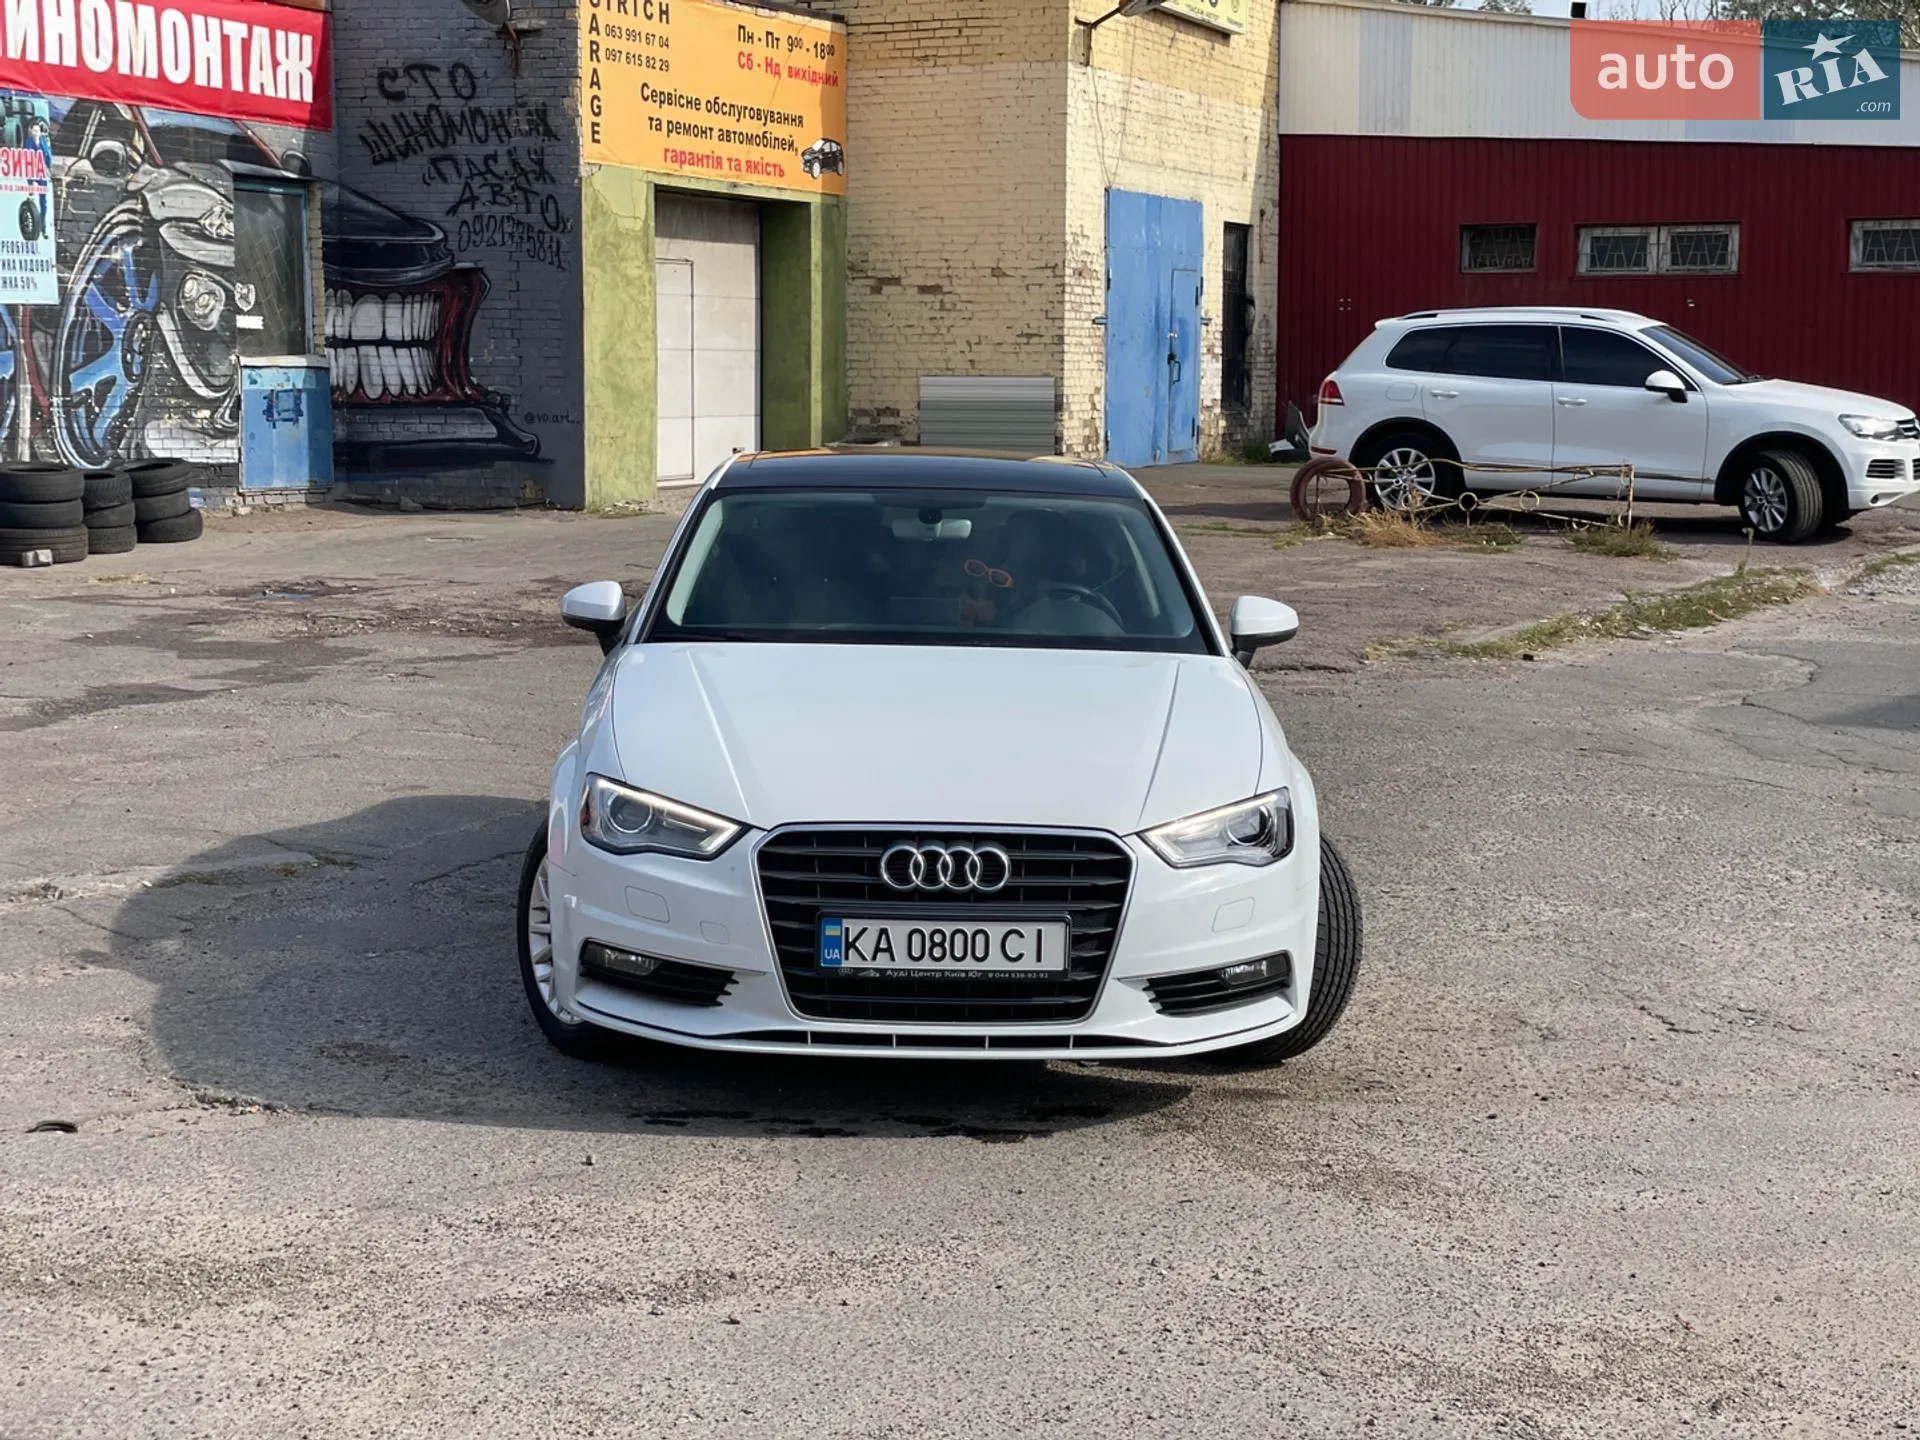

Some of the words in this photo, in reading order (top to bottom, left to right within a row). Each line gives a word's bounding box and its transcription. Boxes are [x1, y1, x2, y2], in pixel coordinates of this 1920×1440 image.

[0, 0, 314, 103] ИНОМОНТАЖ
[605, 23, 622, 39] 063
[625, 28, 642, 43] 991
[645, 32, 656, 46] 67
[659, 36, 670, 50] 04
[738, 24, 754, 44] Пн
[766, 30, 781, 50] Пт
[605, 48, 622, 63] 097
[625, 52, 643, 67] 615
[645, 56, 656, 70] 82
[659, 59, 670, 72] 29
[737, 51, 753, 70] Сб
[765, 56, 781, 78] Нд
[787, 66, 839, 87] вихідний
[377, 62, 477, 101] СТО
[641, 82, 701, 111] Сервісне
[705, 97, 804, 128] обслуговування
[648, 116, 663, 132] та
[666, 119, 714, 142] ремонт
[717, 128, 799, 156] автомобілей,
[1, 148, 47, 178] ЗИНА
[663, 146, 722, 170] гарантія
[727, 157, 741, 172] та
[746, 156, 785, 178] якість
[824, 949, 841, 960] UA
[844, 926, 896, 962] KA
[906, 927, 991, 963] 0800
[1000, 928, 1043, 963] CI
[885, 969, 908, 979] Ауді
[910, 970, 942, 980] Центр
[944, 970, 966, 978] Київ
[968, 970, 983, 979] Юг
